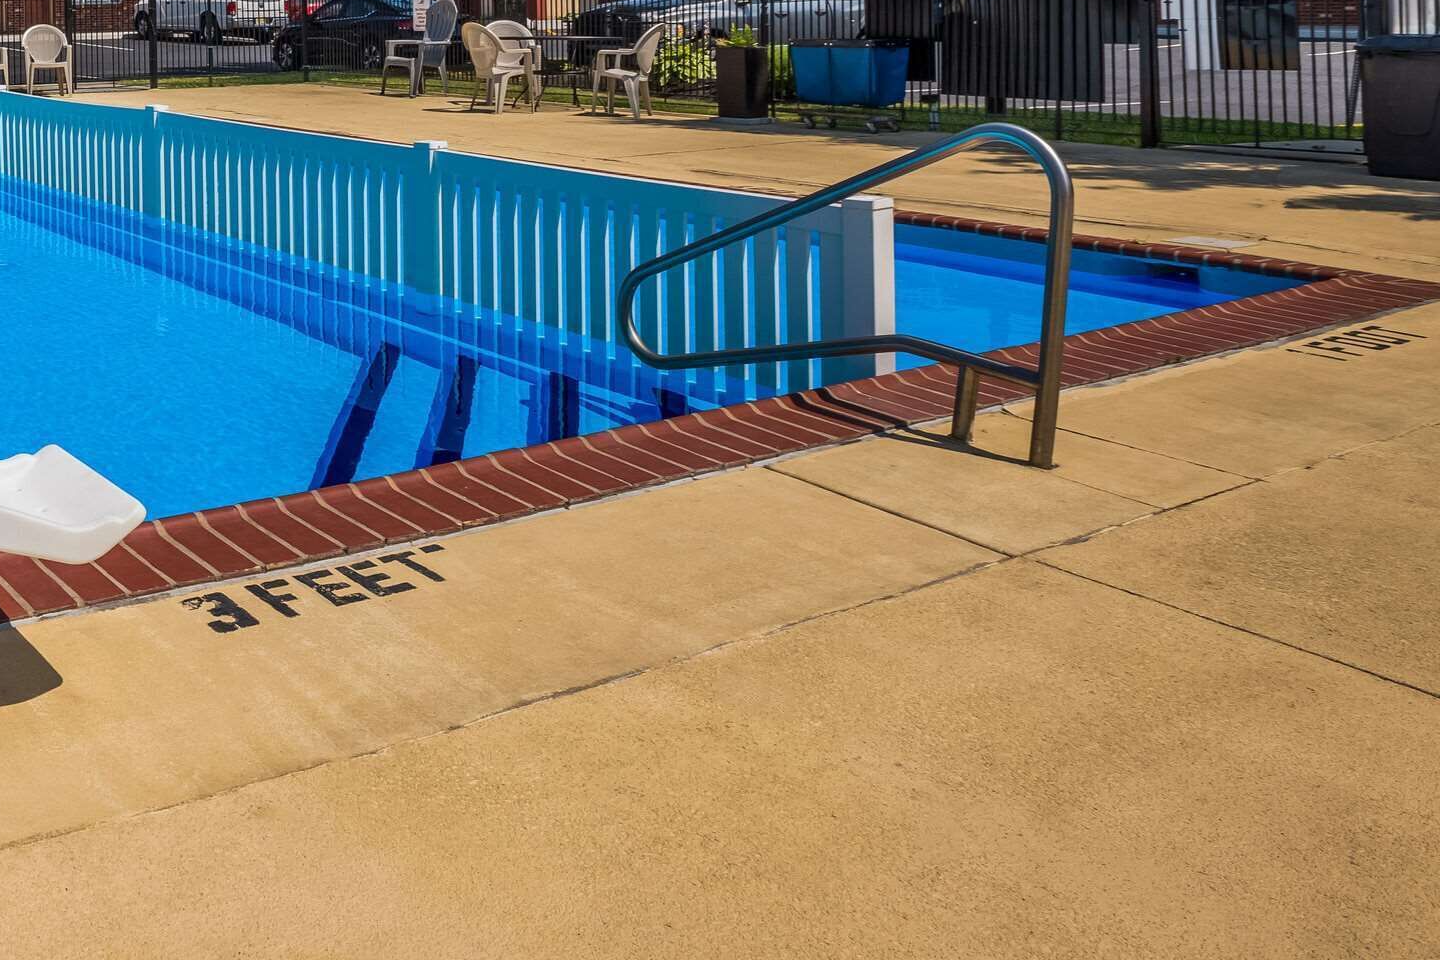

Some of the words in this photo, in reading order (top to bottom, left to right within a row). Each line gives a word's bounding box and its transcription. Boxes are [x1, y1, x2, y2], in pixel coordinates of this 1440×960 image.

[1302, 325, 1428, 357] FOOT
[181, 592, 260, 633] 3
[244, 544, 446, 618] FEET
